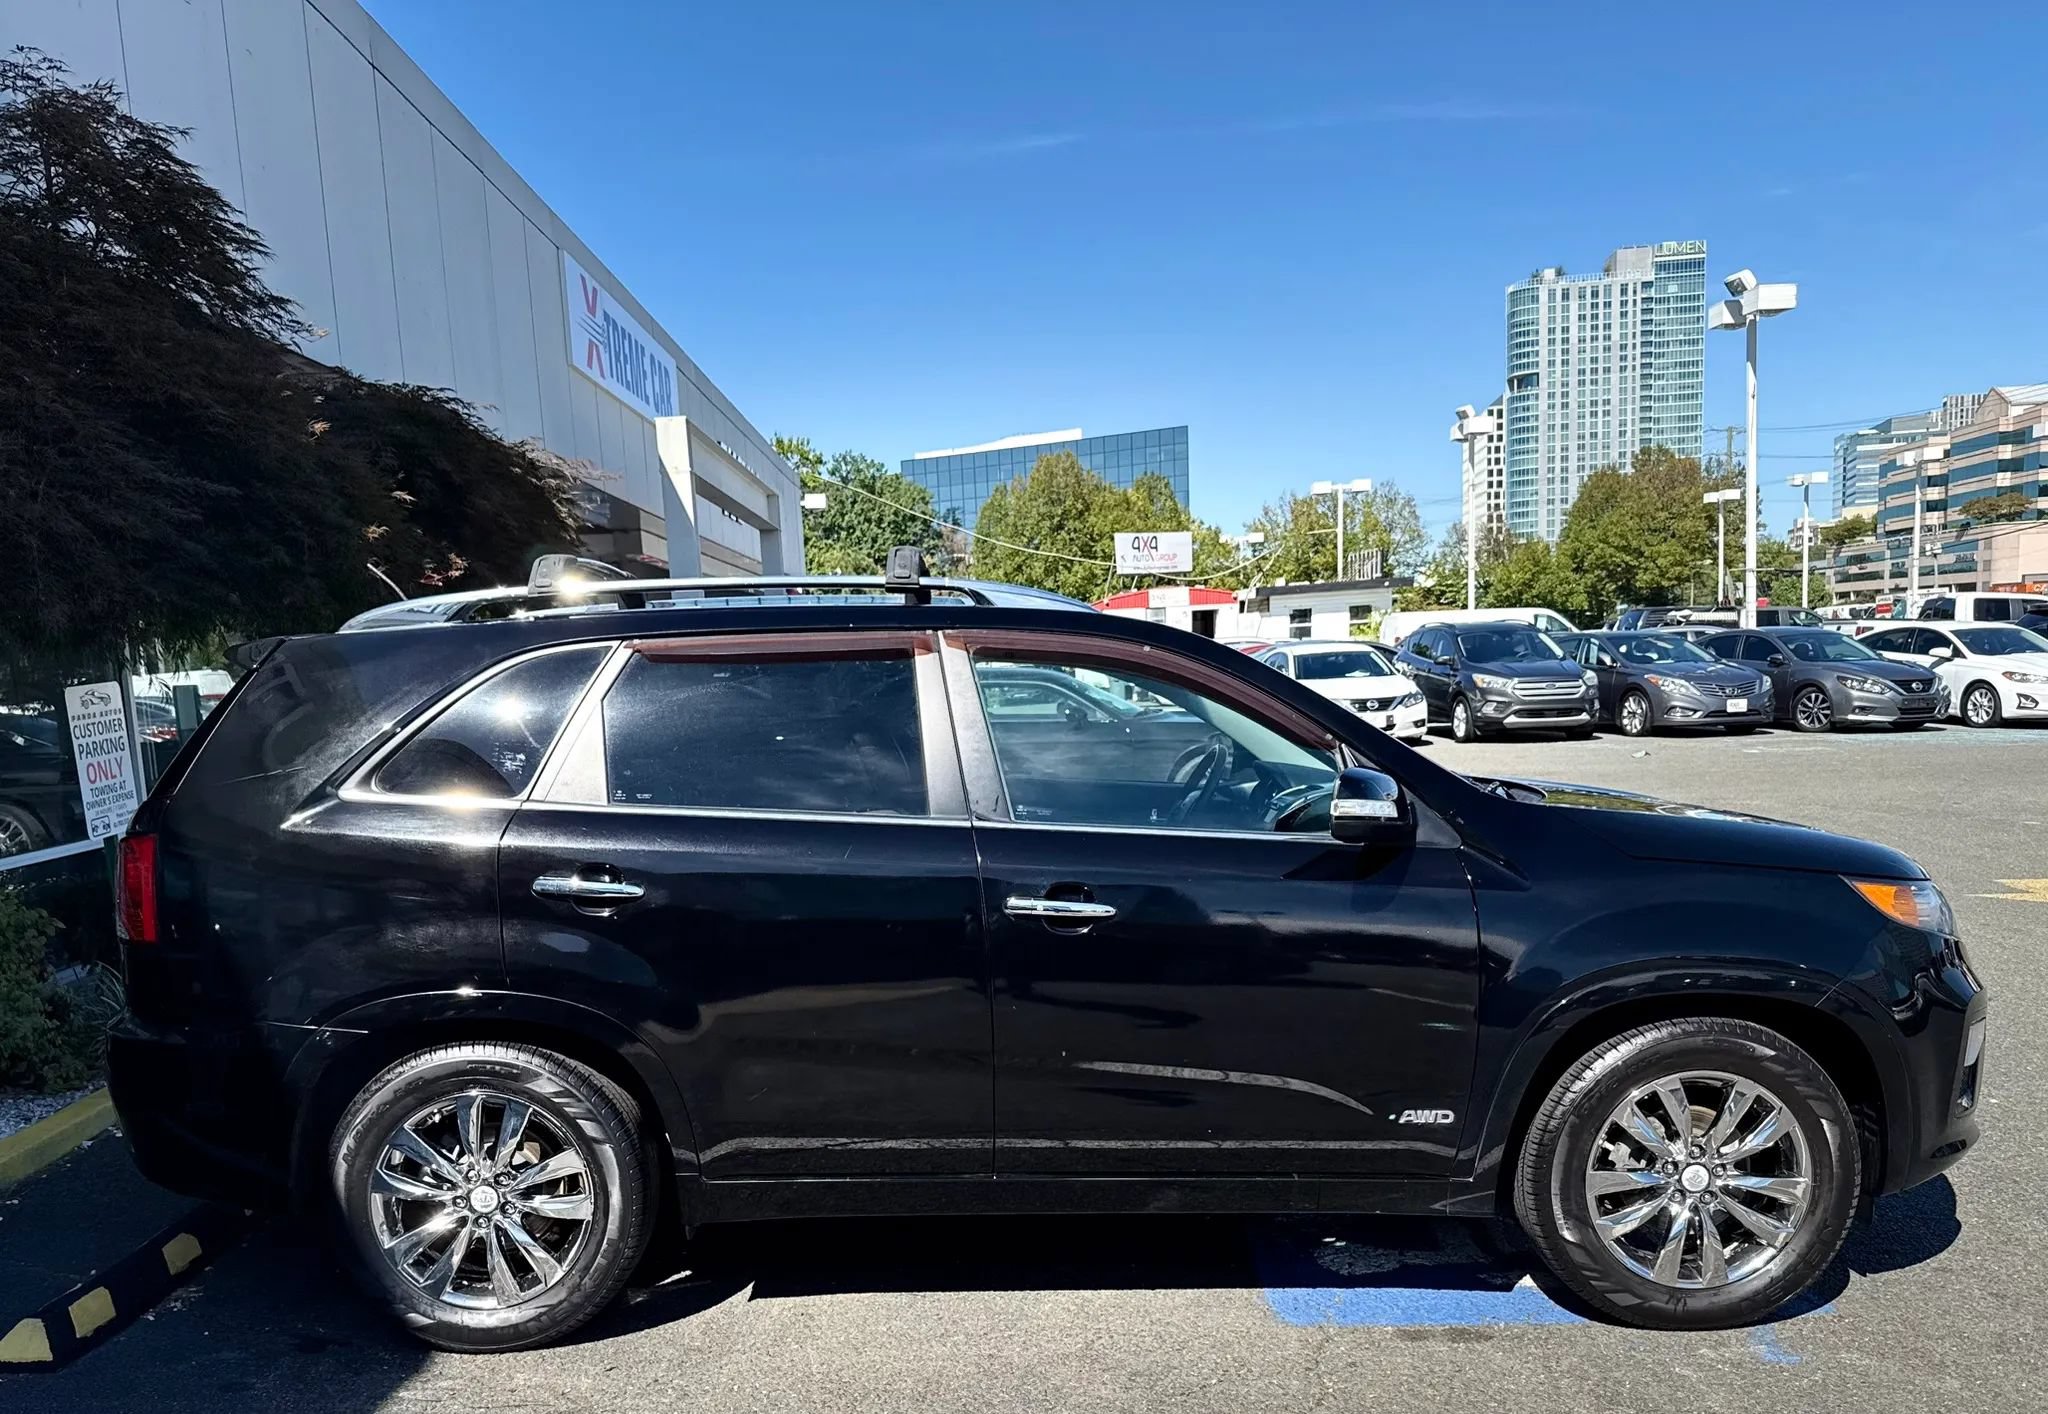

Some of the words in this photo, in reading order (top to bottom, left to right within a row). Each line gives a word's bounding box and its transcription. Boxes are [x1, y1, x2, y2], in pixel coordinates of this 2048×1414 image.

[1655, 240, 1706, 255] LUMEN
[650, 353, 673, 417] CAR
[72, 717, 124, 740] CUSTOMER
[78, 735, 126, 761] PARKING
[86, 756, 123, 785] ONLY
[90, 782, 119, 799] TOWING
[119, 780, 127, 791] AT
[111, 789, 135, 804] EXPENSE
[1398, 1109, 1455, 1124] AWD
